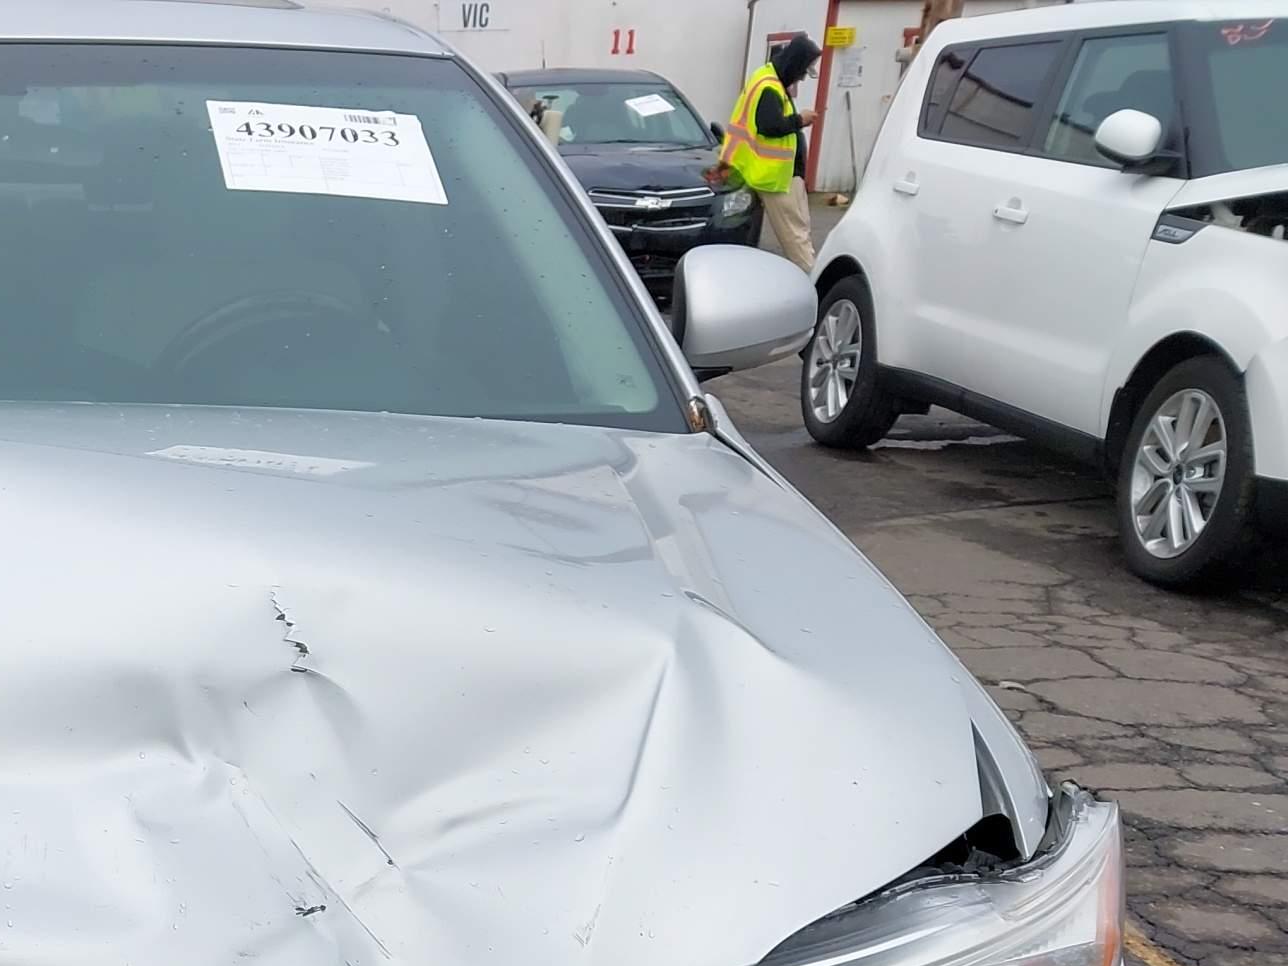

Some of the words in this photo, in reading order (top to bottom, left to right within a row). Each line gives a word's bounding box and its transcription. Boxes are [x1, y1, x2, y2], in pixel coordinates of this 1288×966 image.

[462, 3, 490, 28] VIC
[611, 29, 635, 55] 11
[236, 121, 399, 147] 43907033
